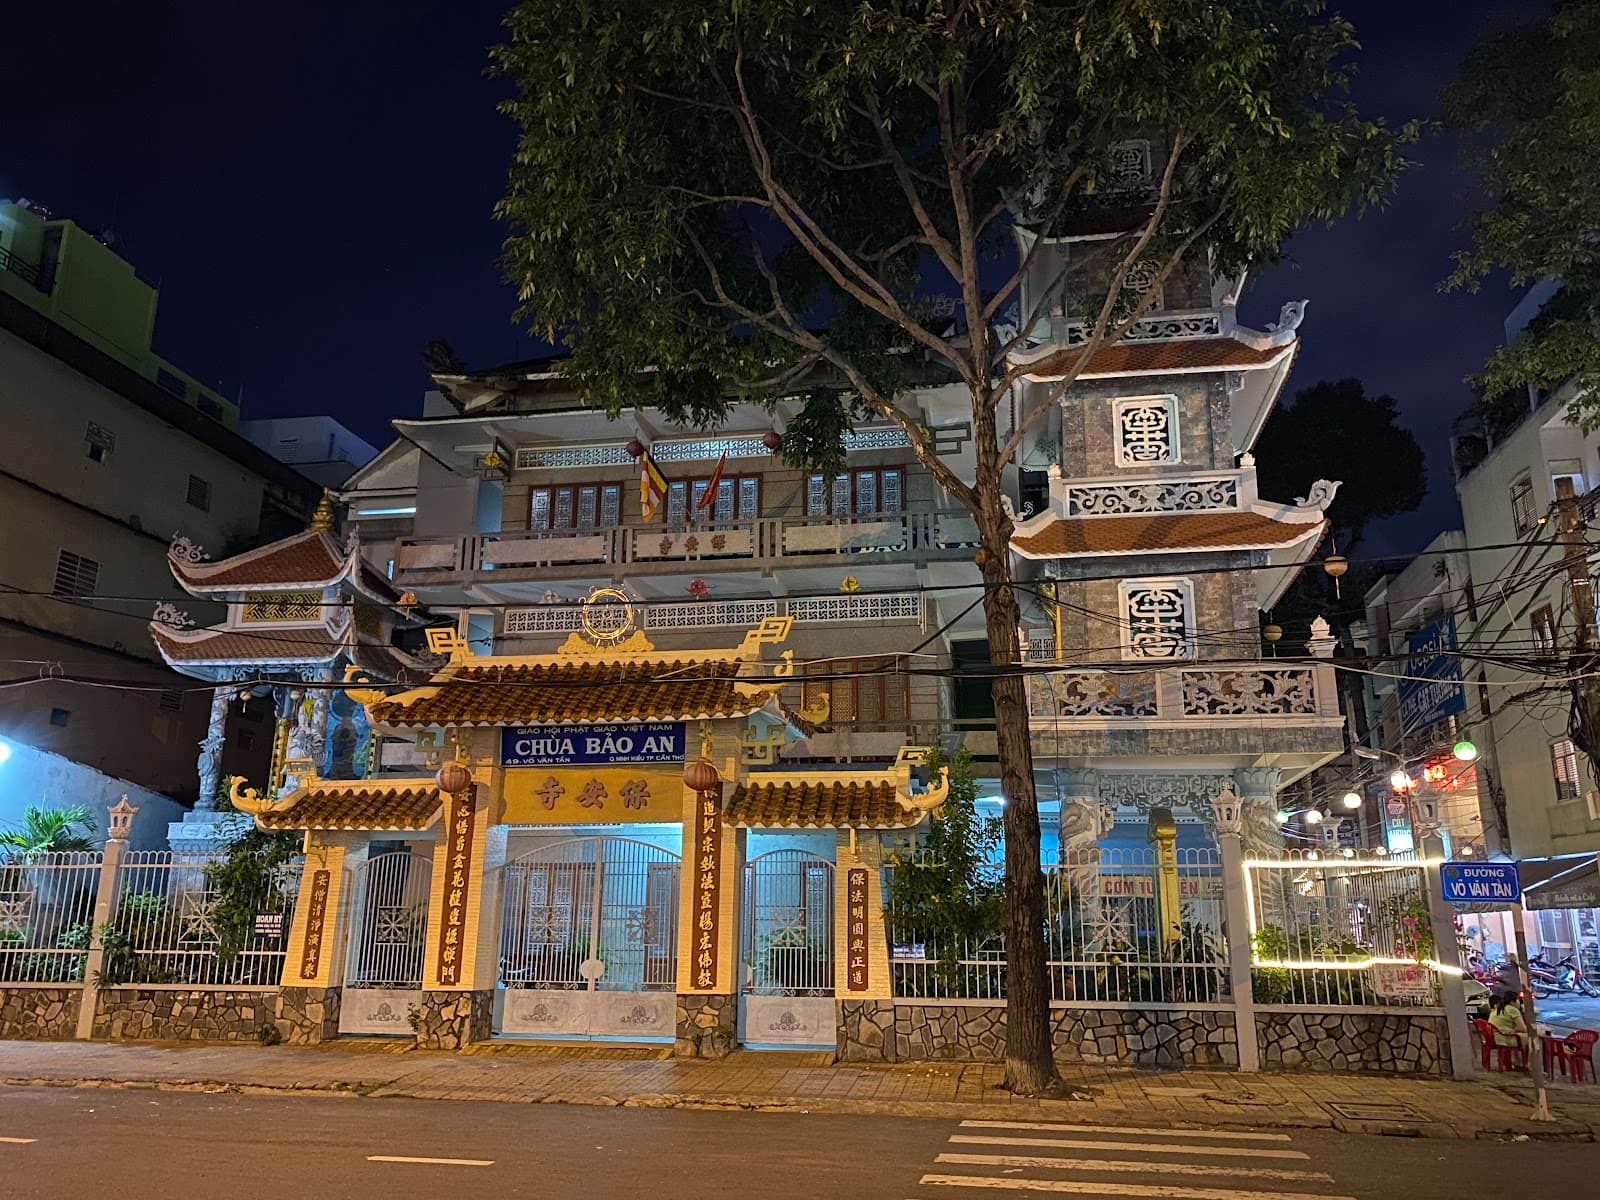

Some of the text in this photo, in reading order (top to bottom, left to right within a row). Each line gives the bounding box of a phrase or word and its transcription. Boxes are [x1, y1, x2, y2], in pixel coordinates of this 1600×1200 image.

[648, 723, 673, 732] NAM
[515, 732, 676, 756] CHÙA BẢO AN
[1463, 866, 1505, 878] ĐƯỜNG
[1450, 879, 1466, 897] VÕ
[1468, 879, 1490, 897] VĂN
